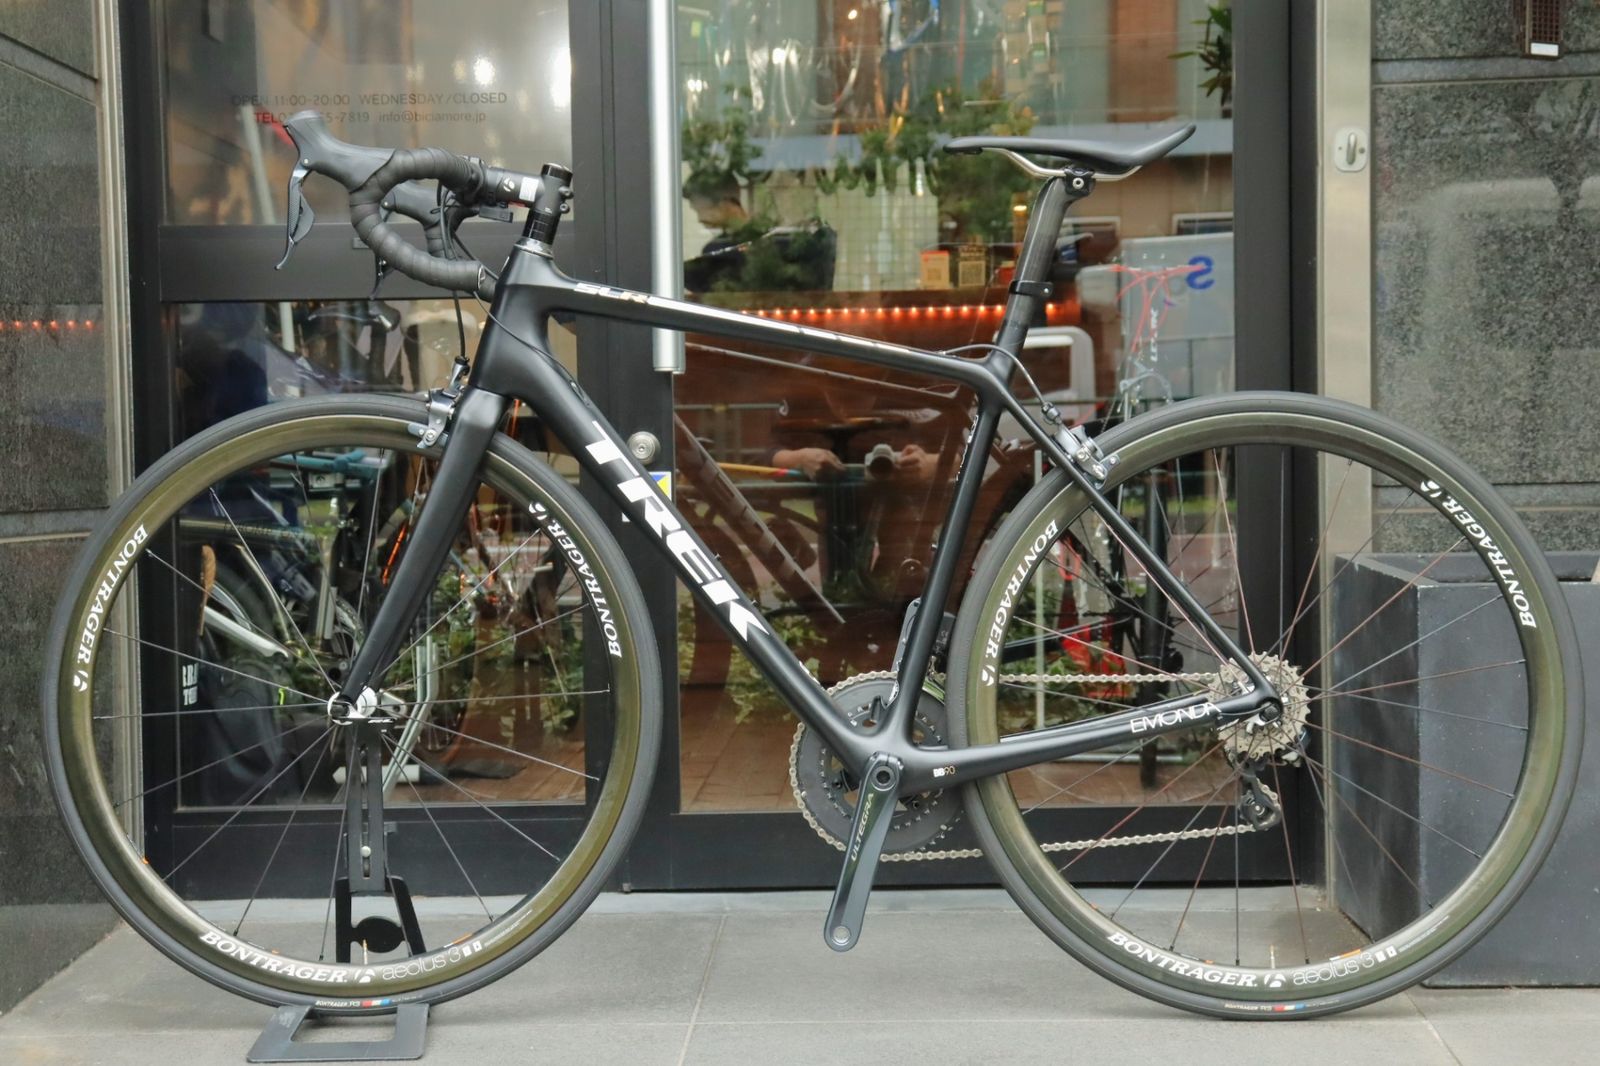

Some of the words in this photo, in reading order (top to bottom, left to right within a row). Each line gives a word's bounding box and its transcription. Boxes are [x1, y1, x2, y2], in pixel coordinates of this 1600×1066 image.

[77, 524, 149, 664] BONTRAGER
[547, 519, 622, 658] BONTRAGER
[585, 420, 770, 642] TREK
[985, 519, 1059, 659] BONTRAGER
[1442, 496, 1537, 628] BONTRAGER
[851, 792, 874, 862] ULTEGRA
[200, 931, 348, 983] BONTRAGER
[1107, 931, 1259, 987] BONTRAGER
